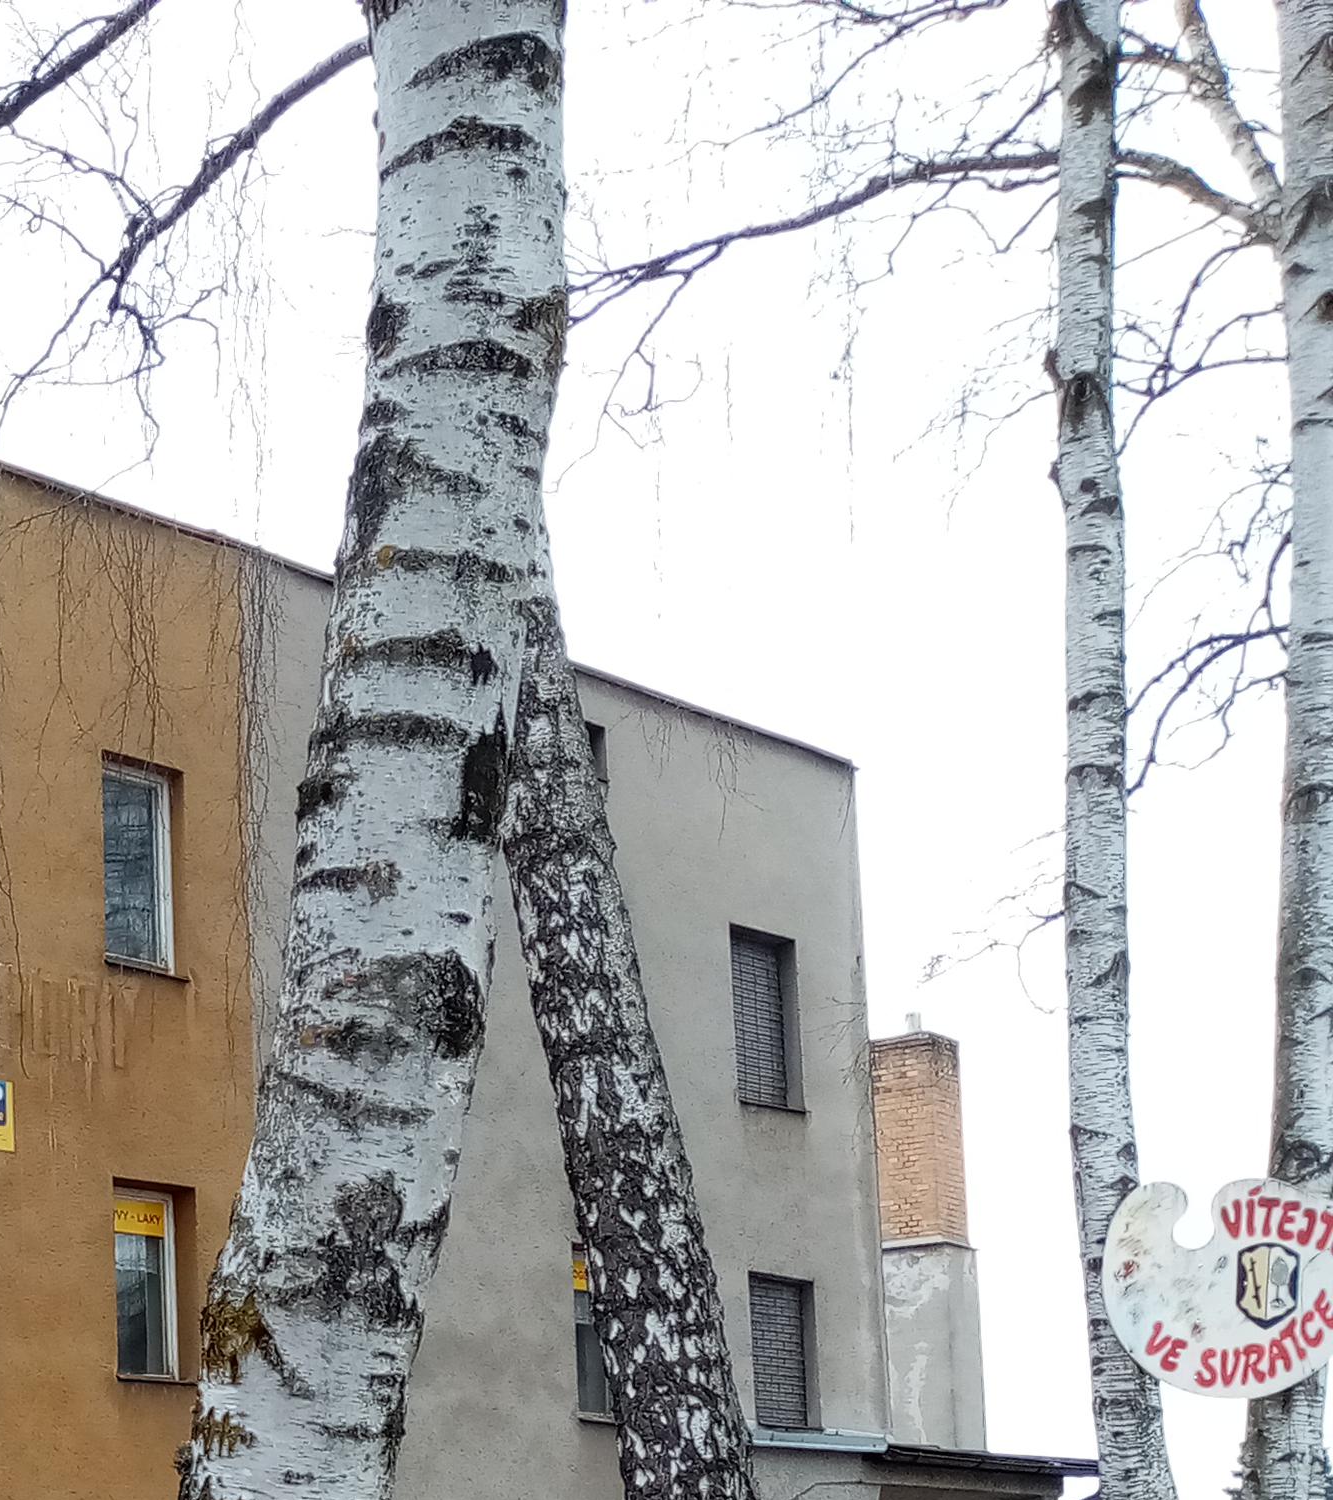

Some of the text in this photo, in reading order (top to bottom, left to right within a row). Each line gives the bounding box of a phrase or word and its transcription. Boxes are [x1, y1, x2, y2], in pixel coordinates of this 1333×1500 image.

[1221, 1185, 1333, 1253] VÍTEJT
[1145, 1289, 1333, 1387] VE SURATCE
